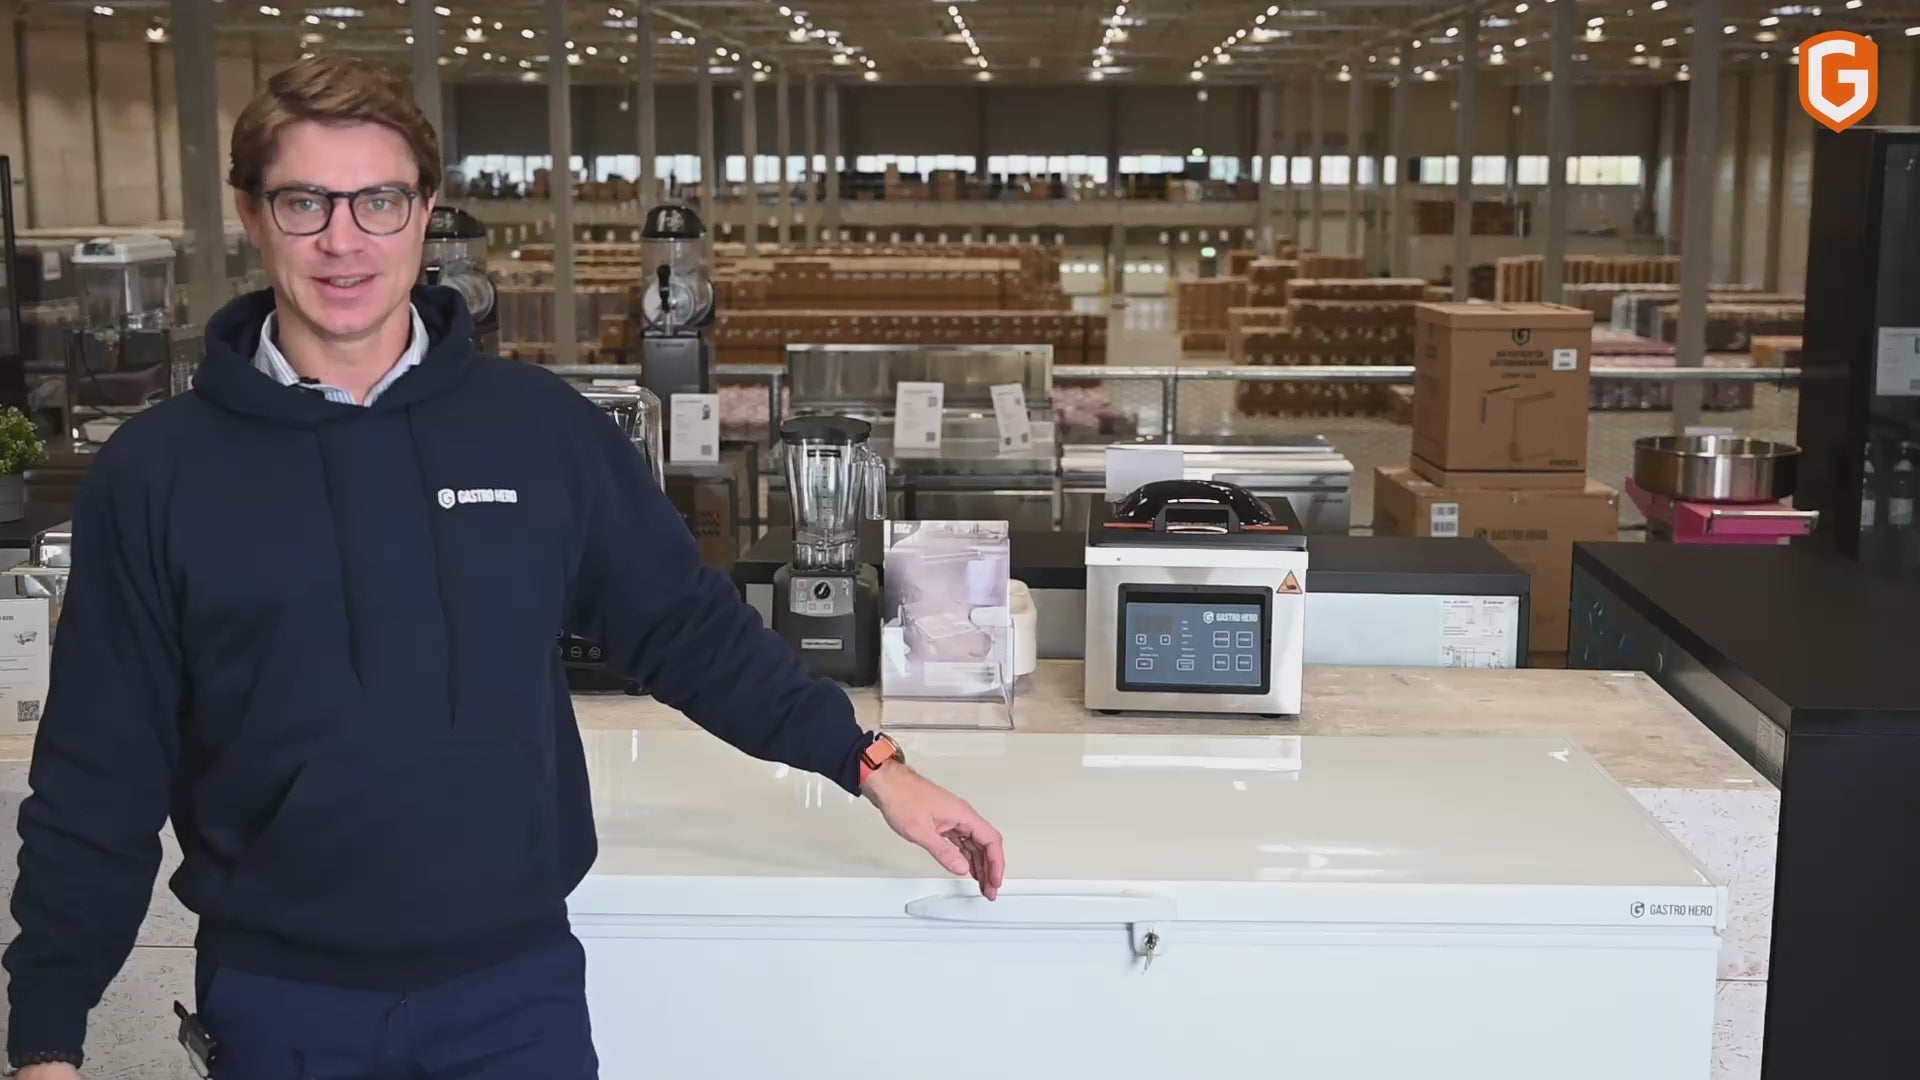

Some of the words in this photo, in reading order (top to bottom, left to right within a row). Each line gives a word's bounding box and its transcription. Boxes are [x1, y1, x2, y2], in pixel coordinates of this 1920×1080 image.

[1216, 612, 1240, 622] GASTRO
[1241, 613, 1259, 622] HERO
[1649, 904, 1686, 916] GASTRO
[1688, 904, 1713, 917] HERO
